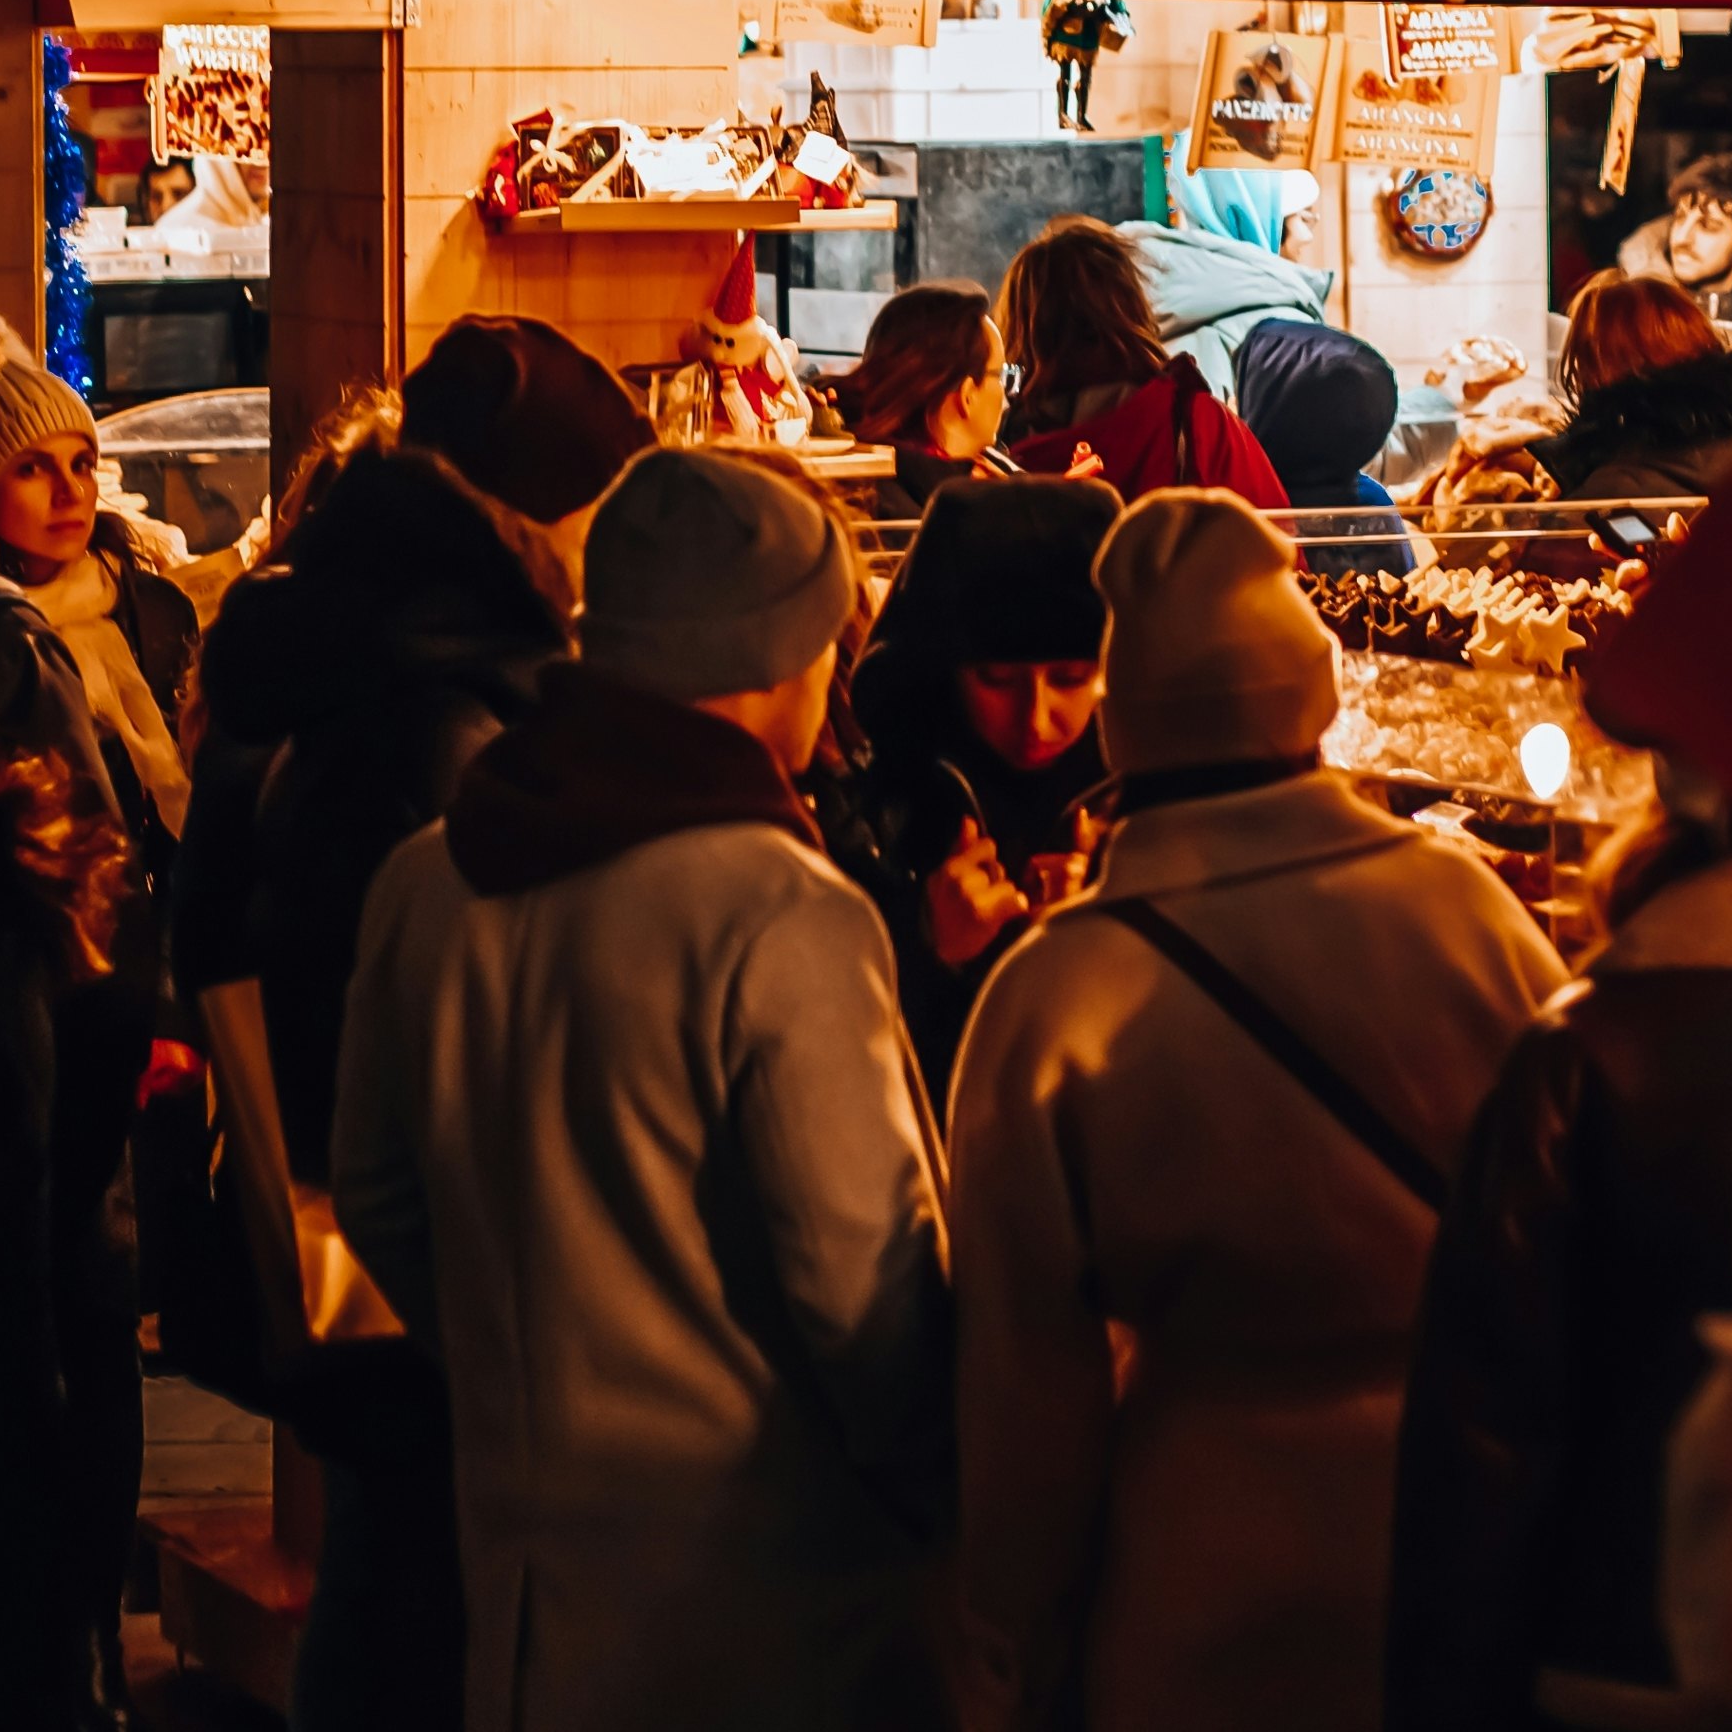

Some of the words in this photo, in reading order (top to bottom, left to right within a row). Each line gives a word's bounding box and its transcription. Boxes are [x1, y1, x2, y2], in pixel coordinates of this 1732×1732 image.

[1409, 11, 1488, 30] ARANCINA
[164, 24, 269, 49] ARTOCCIO
[1410, 40, 1490, 59] ARANCINA
[1357, 106, 1463, 129] ARANCINA
[1354, 134, 1460, 157] ARANCINA
